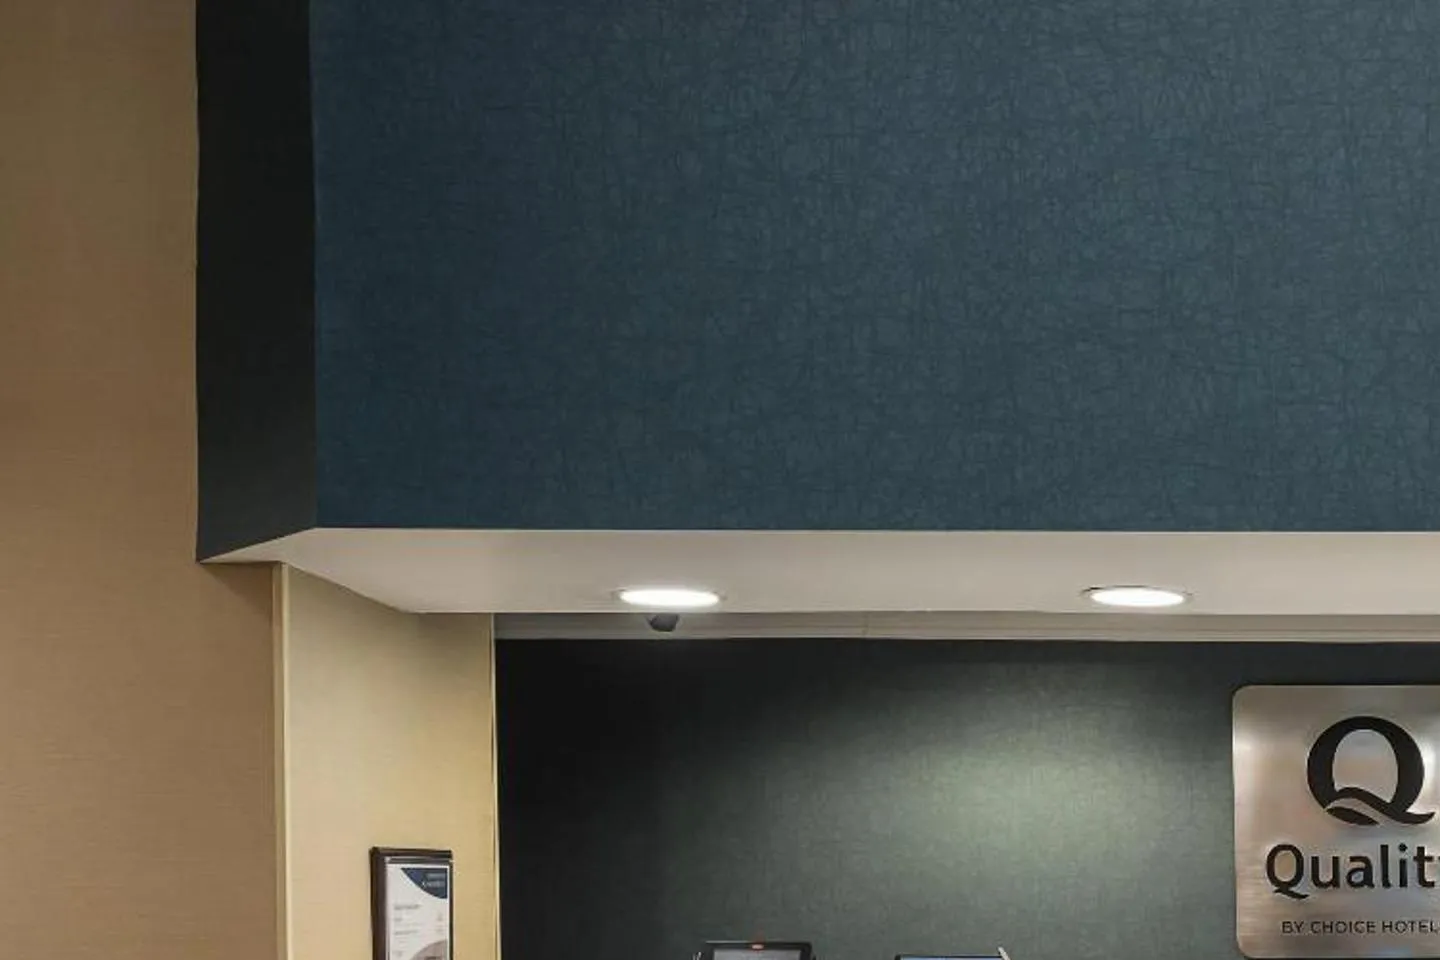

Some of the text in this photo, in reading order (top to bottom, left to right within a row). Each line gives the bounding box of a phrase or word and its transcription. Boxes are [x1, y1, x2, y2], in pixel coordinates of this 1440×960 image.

[1307, 716, 1436, 826] Q
[1281, 920, 1304, 934] BY
[1310, 920, 1376, 934] CHOICE
